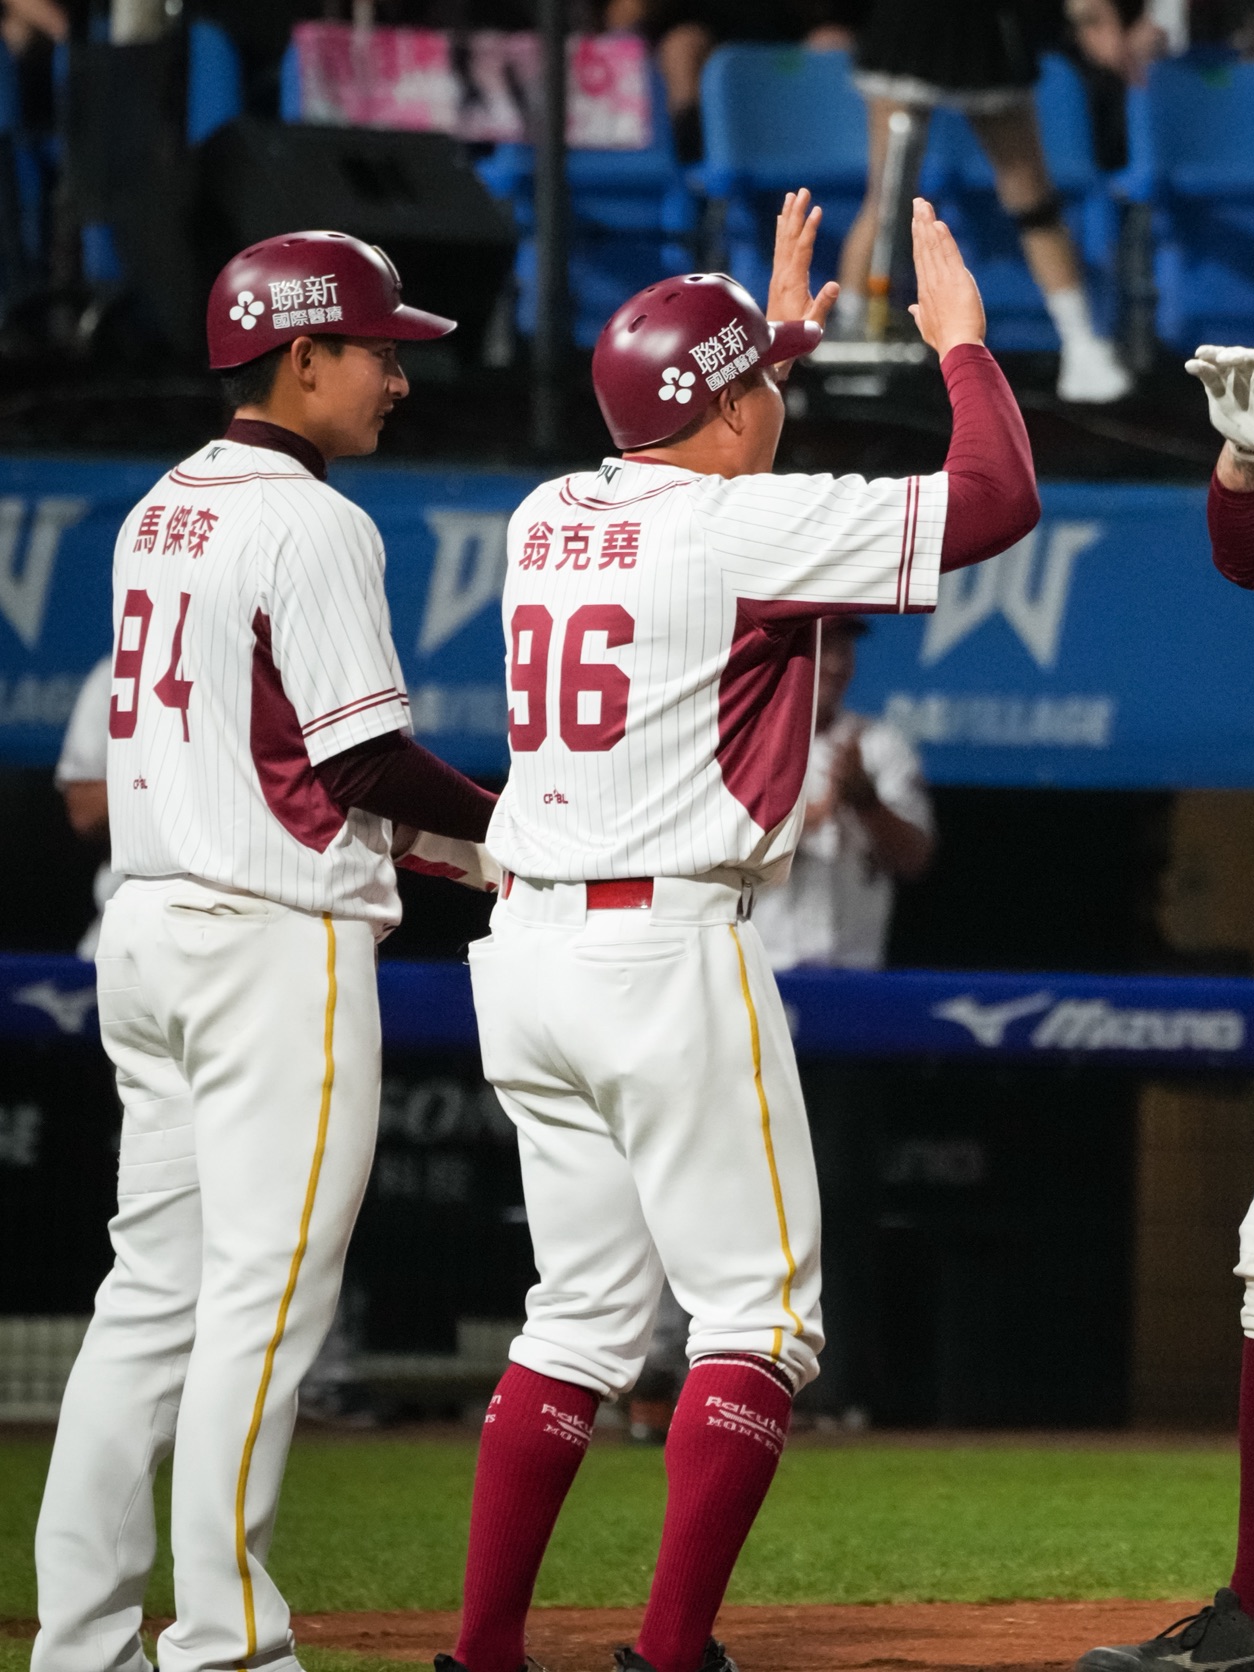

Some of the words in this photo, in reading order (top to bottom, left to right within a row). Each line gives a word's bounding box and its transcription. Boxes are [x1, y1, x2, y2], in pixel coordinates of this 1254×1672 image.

[268, 274, 338, 311] 聯新
[272, 306, 344, 330] 國際醫療
[688, 318, 748, 375] 聯新
[705, 345, 760, 392] 國際醫療
[518, 520, 642, 571] 翁克堯
[109, 589, 194, 742] 94
[509, 604, 635, 752] 96
